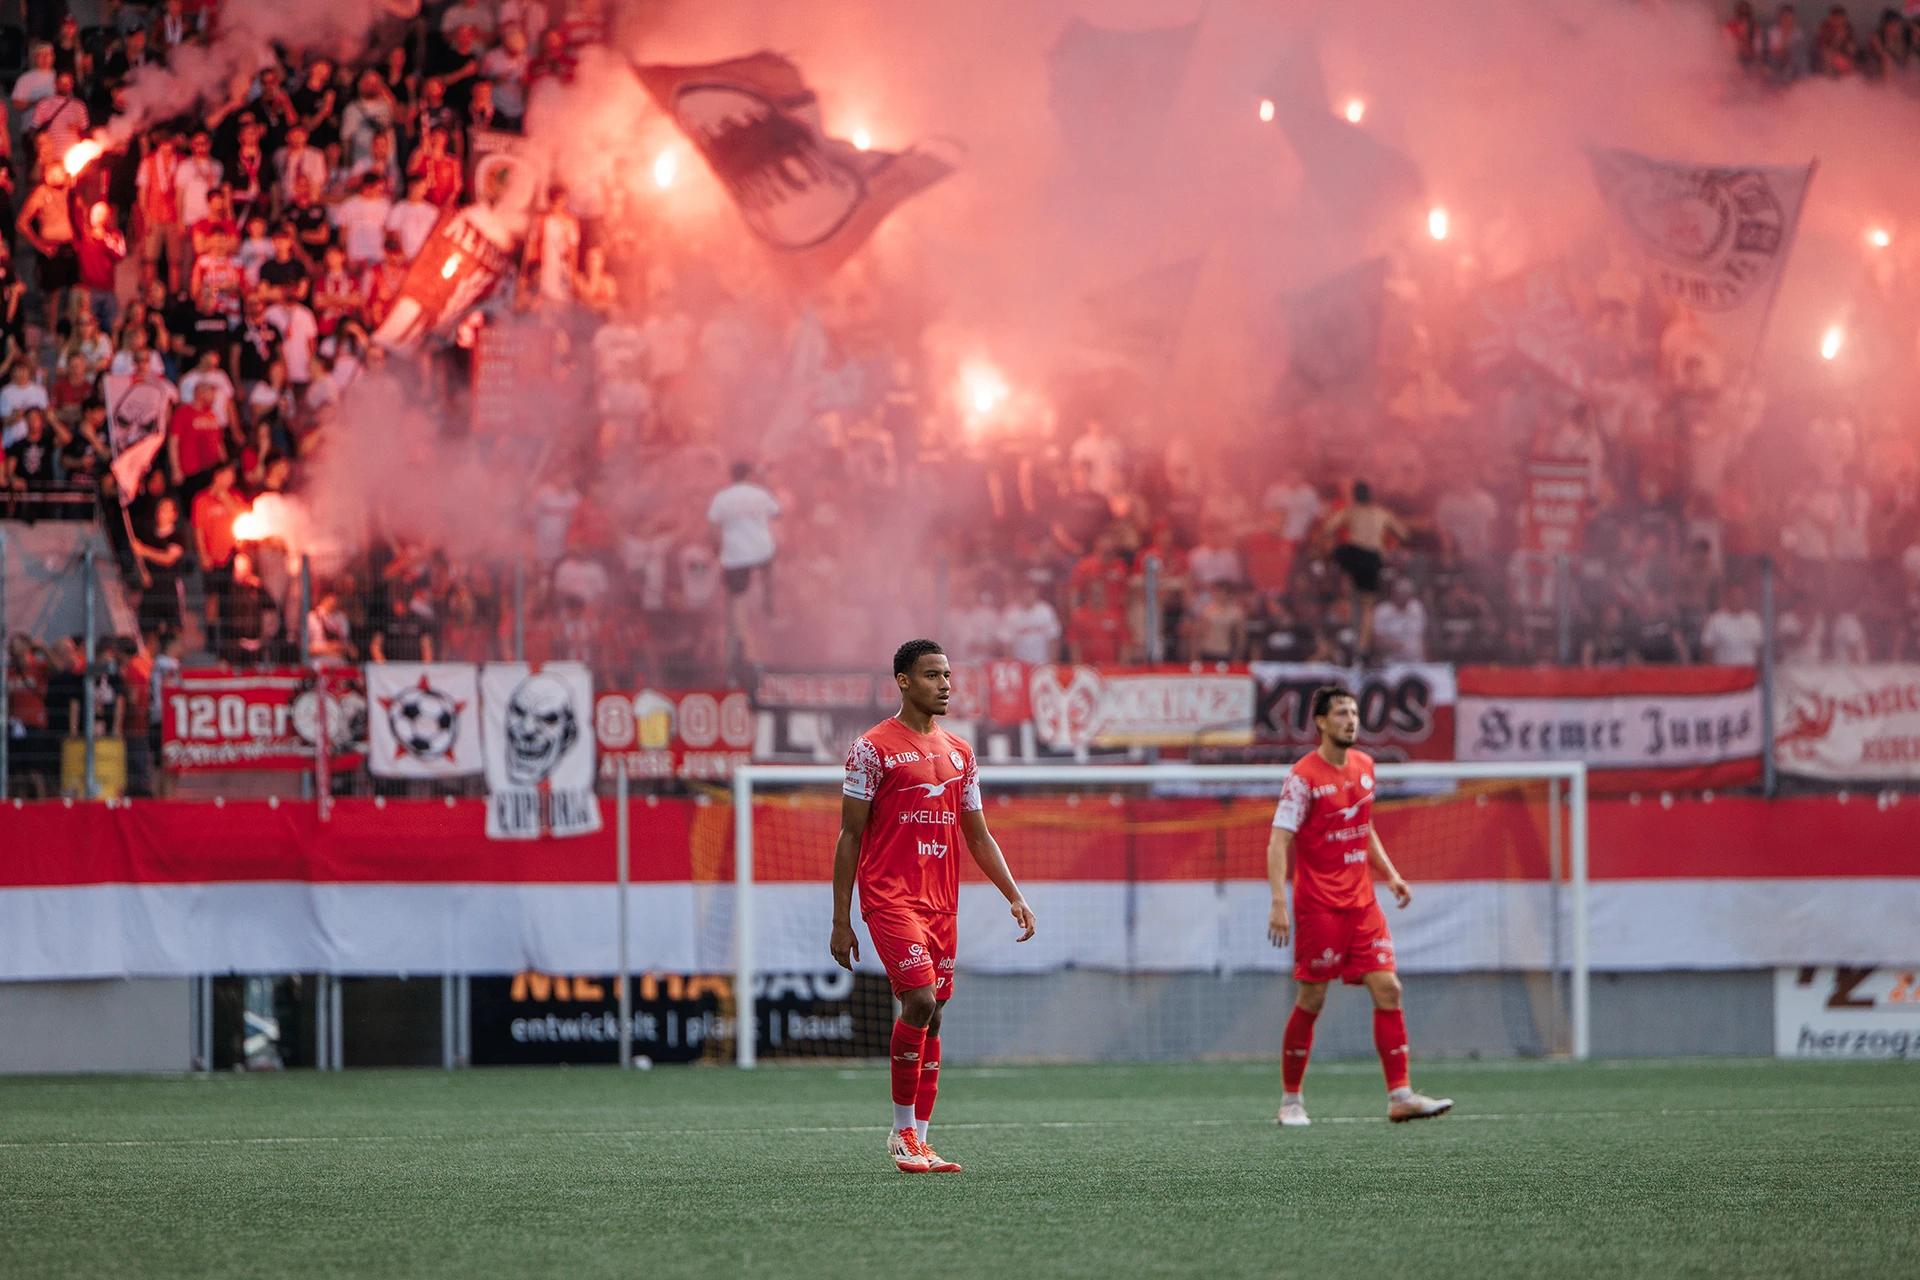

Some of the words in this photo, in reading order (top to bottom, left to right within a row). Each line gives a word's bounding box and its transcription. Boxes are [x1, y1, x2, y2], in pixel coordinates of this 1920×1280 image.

[169, 694, 288, 739] 120er
[895, 751, 919, 763] UBS
[910, 810, 956, 825] KELLER
[917, 839, 948, 859] Init7
